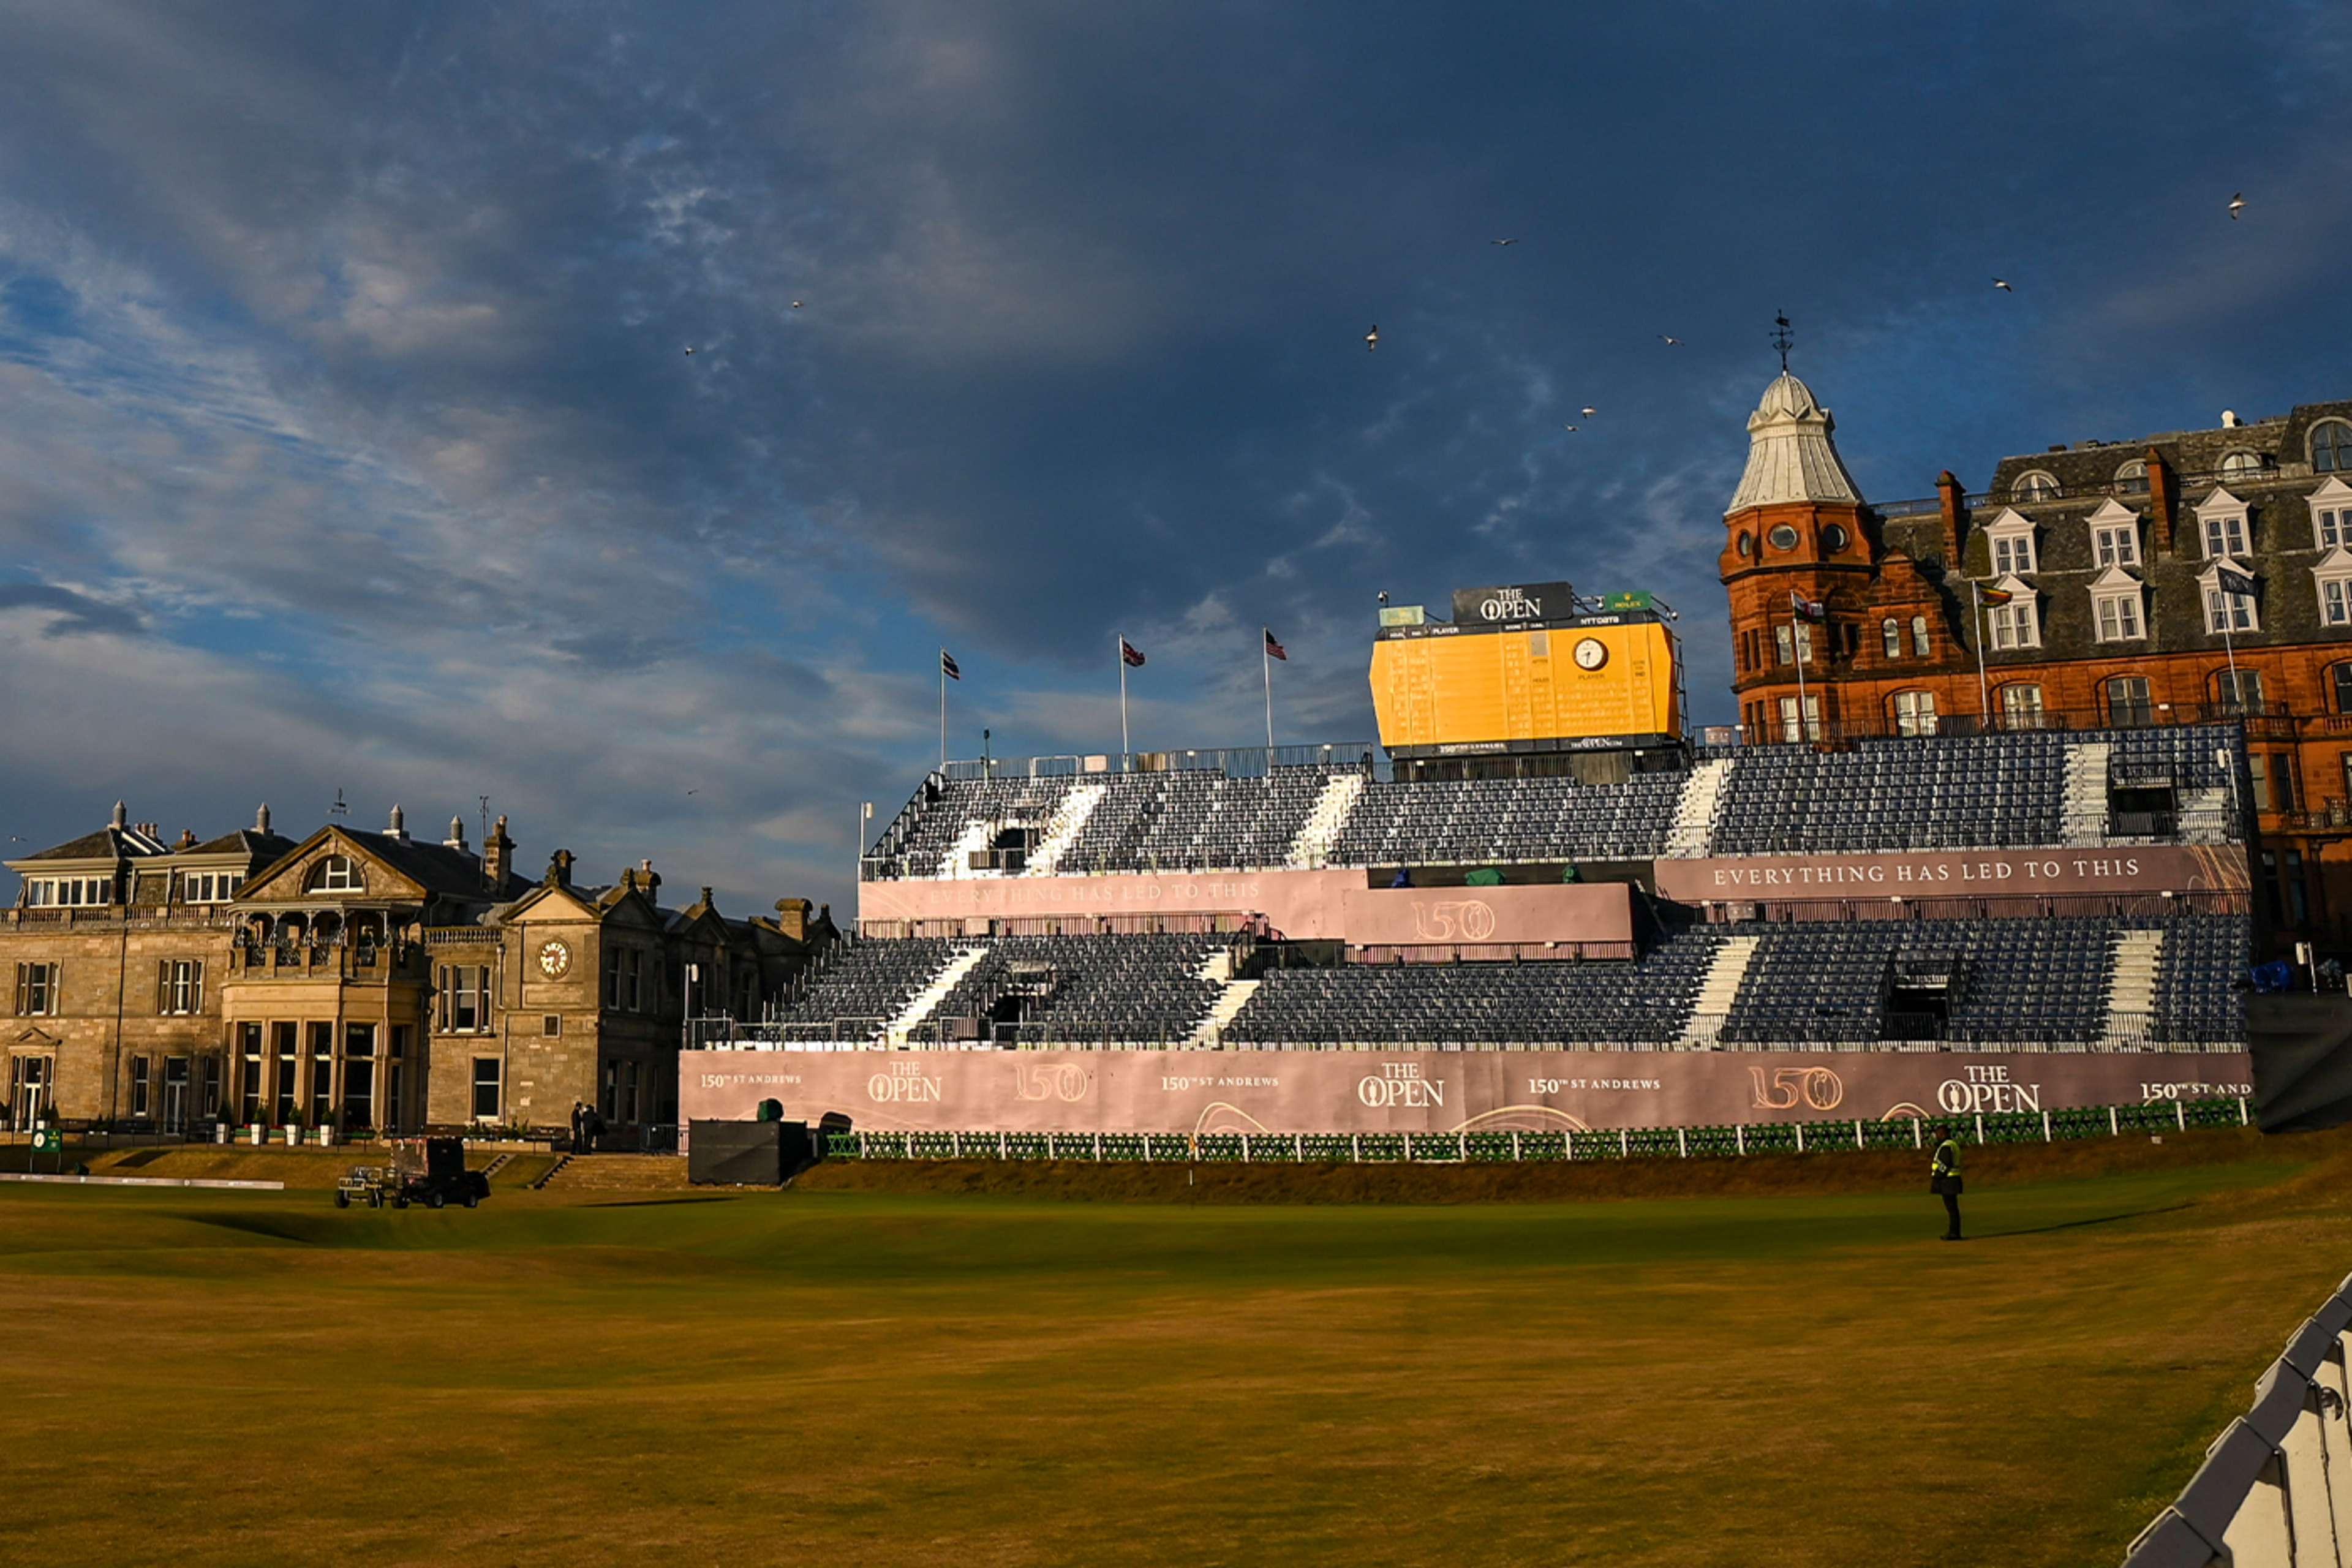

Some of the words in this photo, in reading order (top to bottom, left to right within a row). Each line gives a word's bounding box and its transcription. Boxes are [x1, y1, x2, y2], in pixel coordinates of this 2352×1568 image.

[1497, 589, 1524, 601] THE
[1480, 597, 1540, 620] OPEN
[1432, 626, 1459, 635] PLAYER
[1578, 673, 1606, 681] PLAYER
[1715, 866, 1883, 884] EVERYTHING
[1898, 865, 1948, 880] HAS
[1963, 863, 2011, 879] LED
[2024, 862, 2060, 877] TO
[2073, 859, 2138, 876] THIS
[930, 888, 1062, 904] EVERYTHING
[1072, 888, 1113, 901] HAS
[1123, 885, 1161, 900] LED
[1171, 884, 1199, 899] TO
[1208, 883, 1260, 898] THIS
[1411, 900, 1495, 940] 150
[889, 1061, 921, 1077] THE
[1382, 1063, 1419, 1079] THE
[1964, 1066, 2009, 1082] THE
[869, 1073, 942, 1102] OPEN
[1014, 1063, 1088, 1102] 150
[1218, 1077, 1278, 1086] ANDREWS
[1359, 1075, 1444, 1106] OPEN
[1571, 1079, 1586, 1088] ST
[1591, 1080, 1660, 1088] ANDREWS
[1749, 1066, 1843, 1109] 150
[2192, 1084, 2209, 1093] ST
[1938, 1079, 2039, 1114] OPEN
